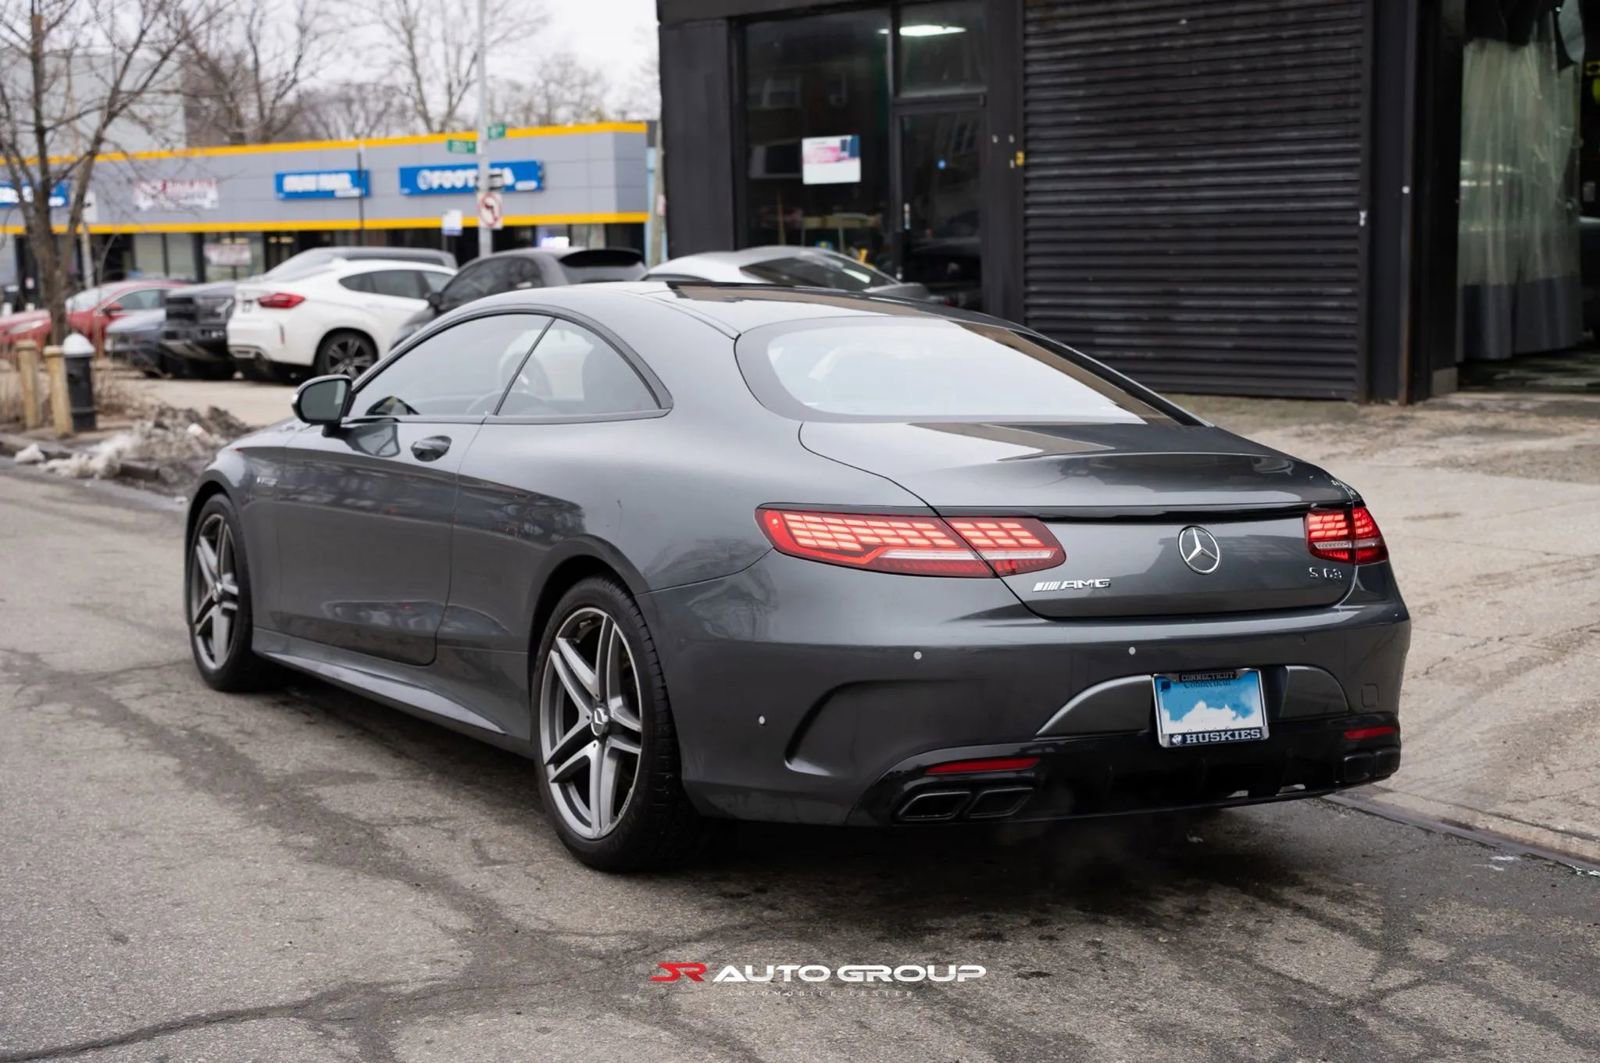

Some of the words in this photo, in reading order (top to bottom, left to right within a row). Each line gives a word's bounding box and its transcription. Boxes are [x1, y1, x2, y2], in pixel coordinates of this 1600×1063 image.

[1309, 567, 1319, 578] S
[1323, 567, 1343, 579] 63
[1059, 578, 1111, 590] AMG
[1185, 729, 1260, 744] HUSKIES
